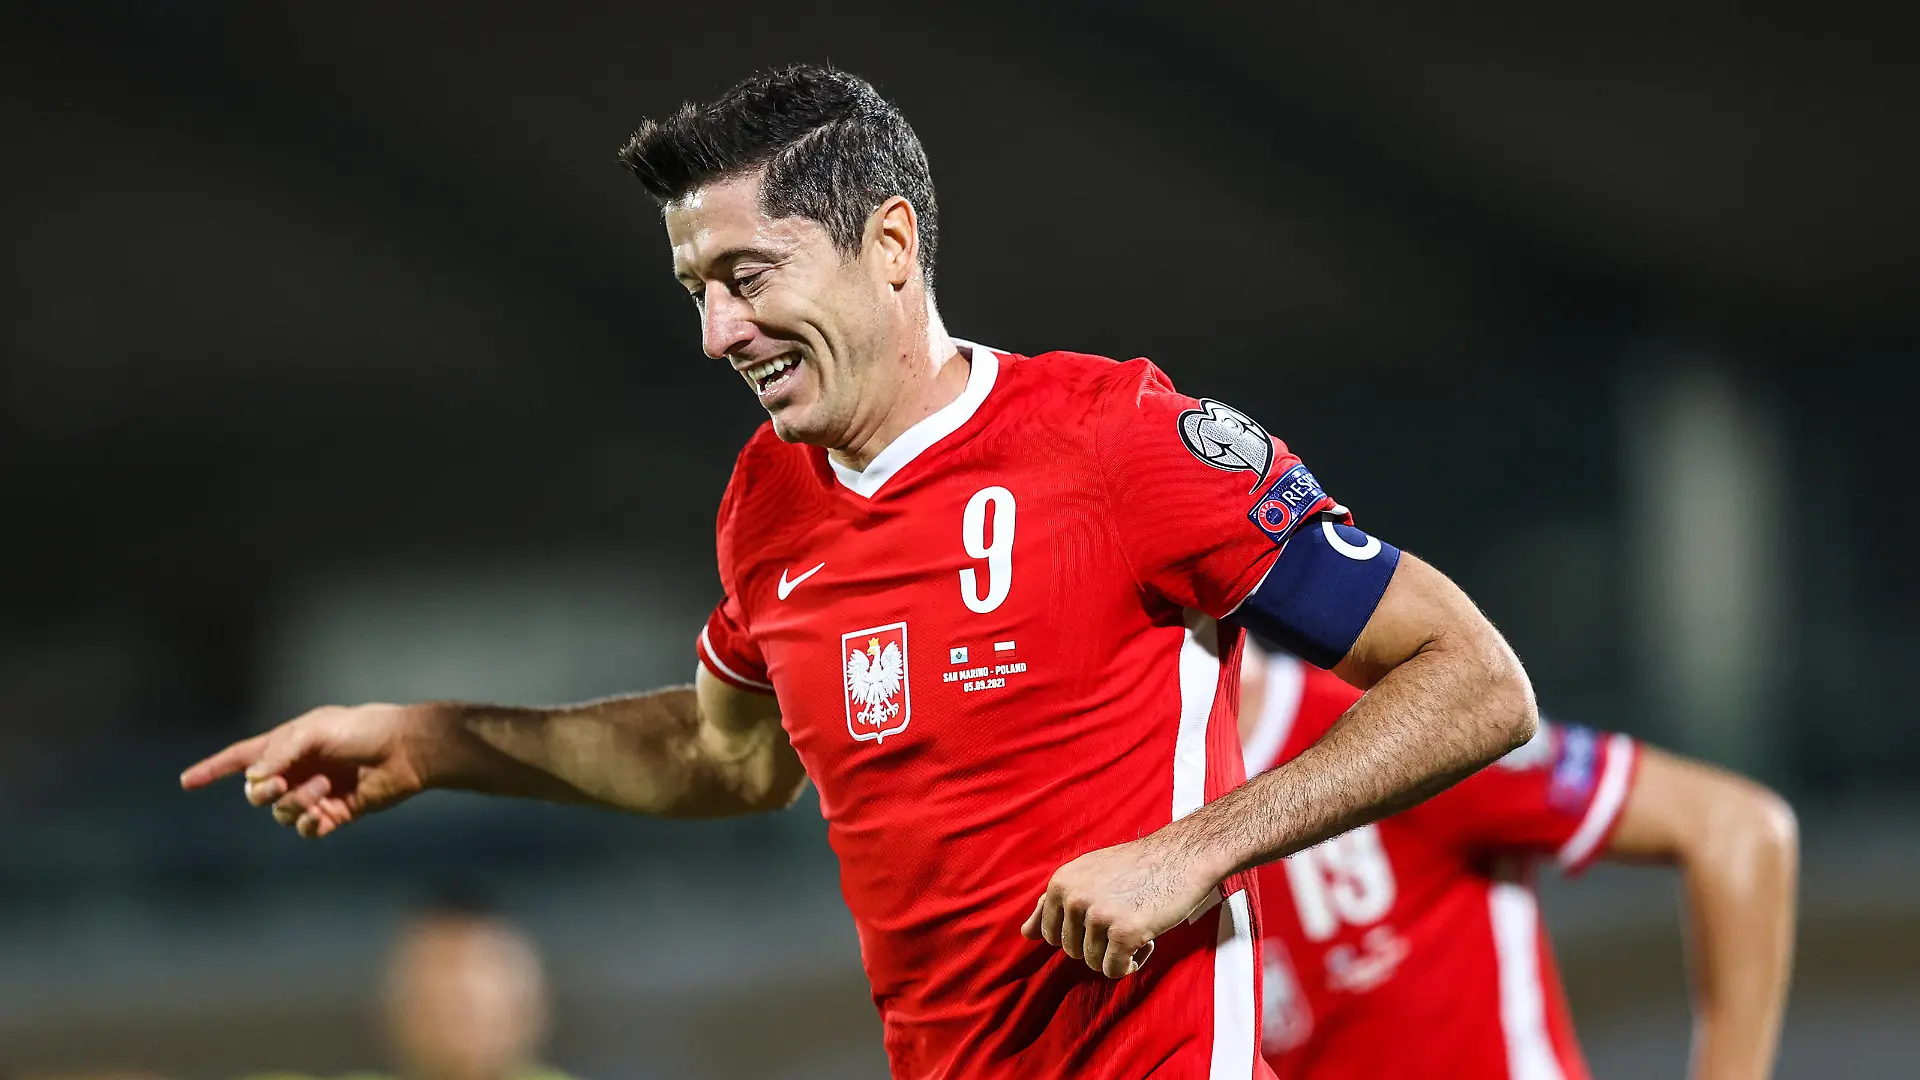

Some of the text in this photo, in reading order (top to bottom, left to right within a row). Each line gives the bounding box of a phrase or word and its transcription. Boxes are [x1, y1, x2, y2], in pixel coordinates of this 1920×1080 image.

[1259, 501, 1275, 518] UEFA
[959, 486, 1016, 614] 9
[943, 671, 958, 682] SAN
[959, 667, 988, 680] MARINO
[995, 662, 1027, 675] POLAND
[963, 678, 1005, 692] 05.09.2021
